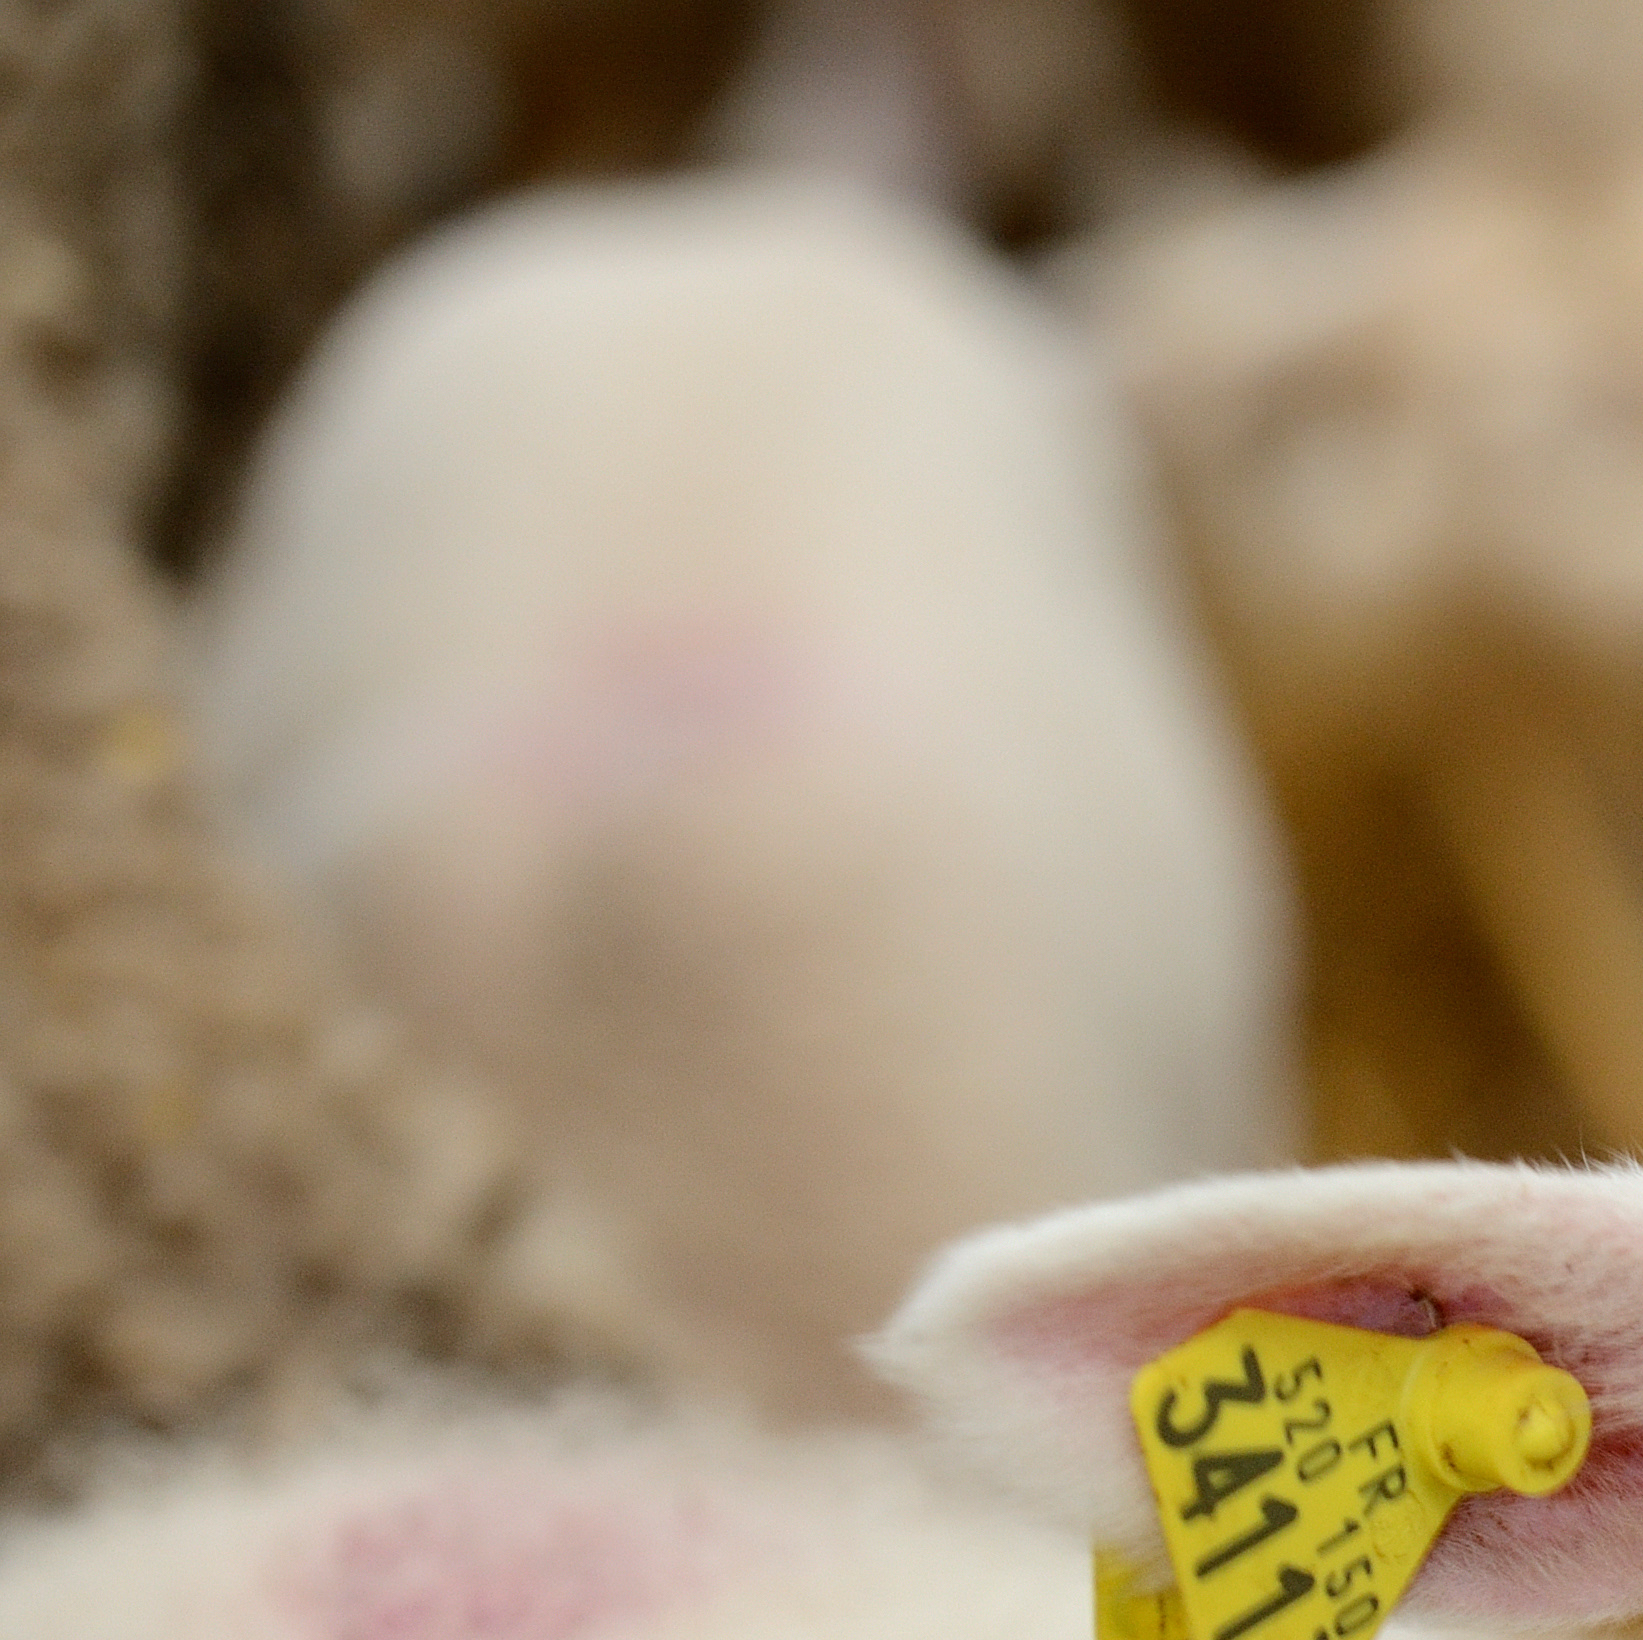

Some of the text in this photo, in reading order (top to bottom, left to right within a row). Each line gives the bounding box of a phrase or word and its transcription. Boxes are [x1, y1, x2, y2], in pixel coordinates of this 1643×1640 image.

[1274, 1356, 1379, 1638] 520 150
[1347, 1420, 1407, 1516] FR
